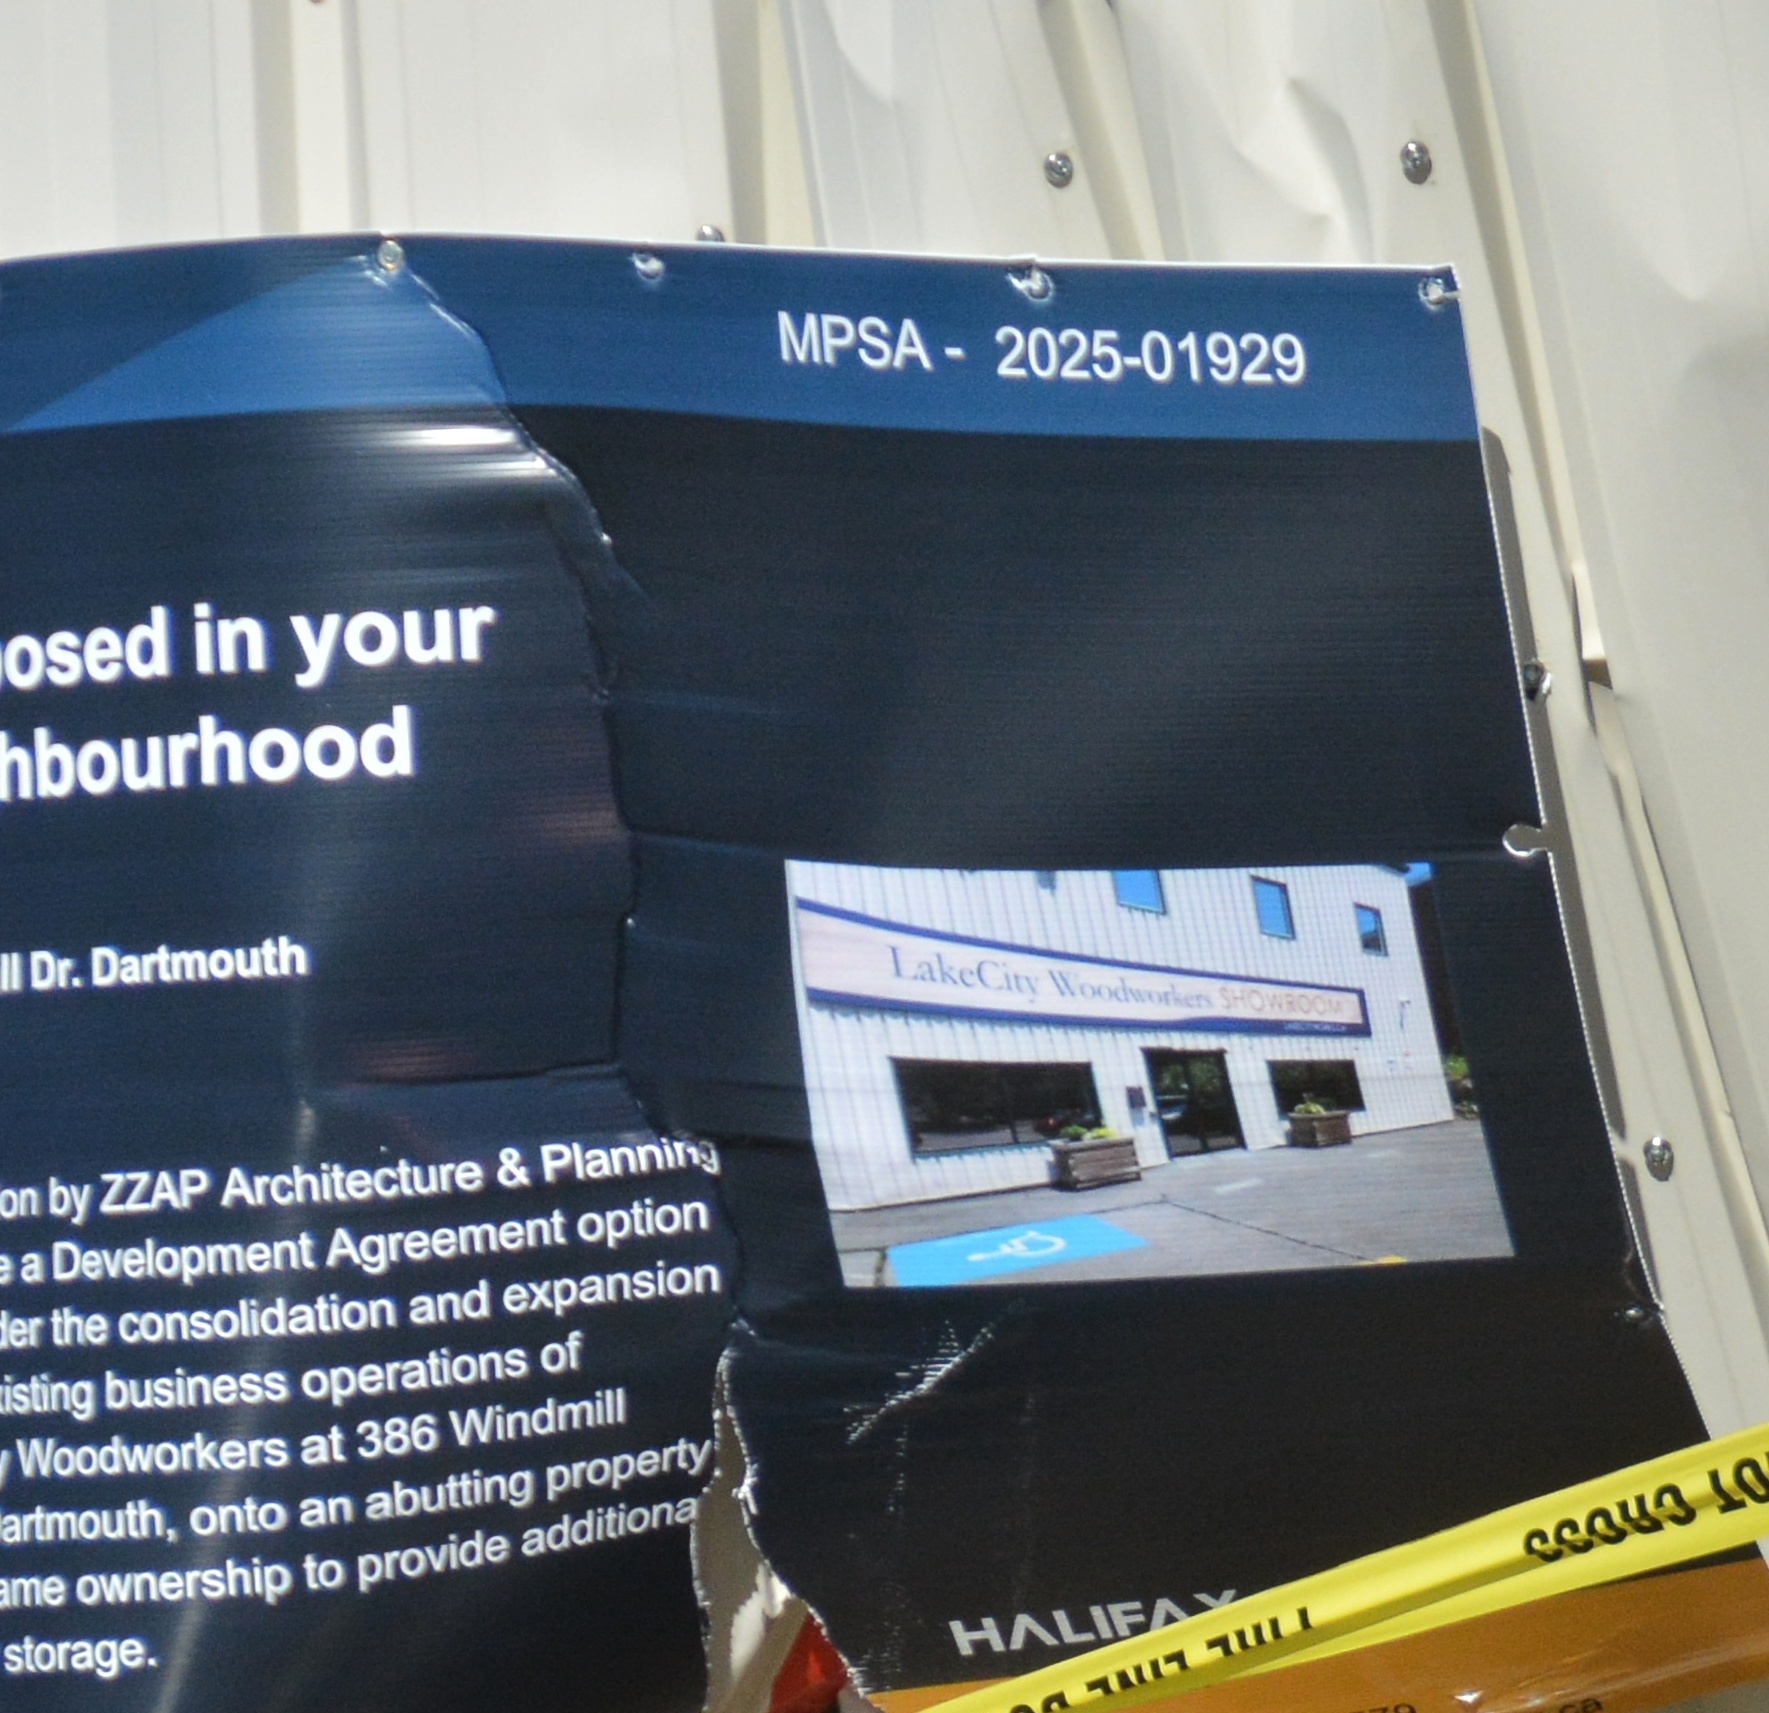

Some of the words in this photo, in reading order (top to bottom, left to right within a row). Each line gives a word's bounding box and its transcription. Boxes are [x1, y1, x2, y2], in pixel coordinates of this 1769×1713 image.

[778, 310, 932, 371] MPSA
[995, 325, 1307, 385] 2025-01929
[0, 605, 170, 692] osed
[193, 601, 267, 675] in
[289, 603, 496, 689] your
[0, 703, 414, 800] hbourhood
[29, 949, 82, 990] Dr.
[90, 934, 311, 987] Dartmouth
[888, 944, 1040, 998] LakeCity
[1046, 966, 1216, 1010] Woodworkers
[1218, 985, 1345, 1017] SHOWROOM
[48, 1175, 93, 1227] by
[99, 1168, 211, 1215] ZZAP
[220, 1158, 485, 1209] Architecture
[496, 1146, 533, 1188] &
[540, 1136, 722, 1184] Planning
[20, 1252, 46, 1284] a
[52, 1236, 316, 1287] Development
[326, 1207, 568, 1276] Agreement
[576, 1196, 710, 1249] option
[51, 1305, 110, 1347] the
[117, 1292, 398, 1345] consolidation
[408, 1278, 491, 1325] and
[502, 1259, 722, 1317] expansion
[104, 1367, 293, 1411] business
[300, 1346, 531, 1408] operations
[539, 1328, 585, 1375] of
[15, 1431, 291, 1479] Woodworkers
[300, 1424, 348, 1466] at
[355, 1413, 440, 1459] 386
[448, 1387, 628, 1447] Windmill
[0, 1499, 180, 1545] artmouth,
[189, 1495, 290, 1536] onto
[298, 1494, 356, 1529] an
[364, 1468, 536, 1510] abutting
[545, 1437, 713, 1502] property
[1521, 1481, 1698, 1564] CROSS
[75, 1557, 294, 1606] ownership
[303, 1552, 349, 1591] to
[357, 1529, 512, 1594] provide
[2, 1634, 161, 1680] storage.
